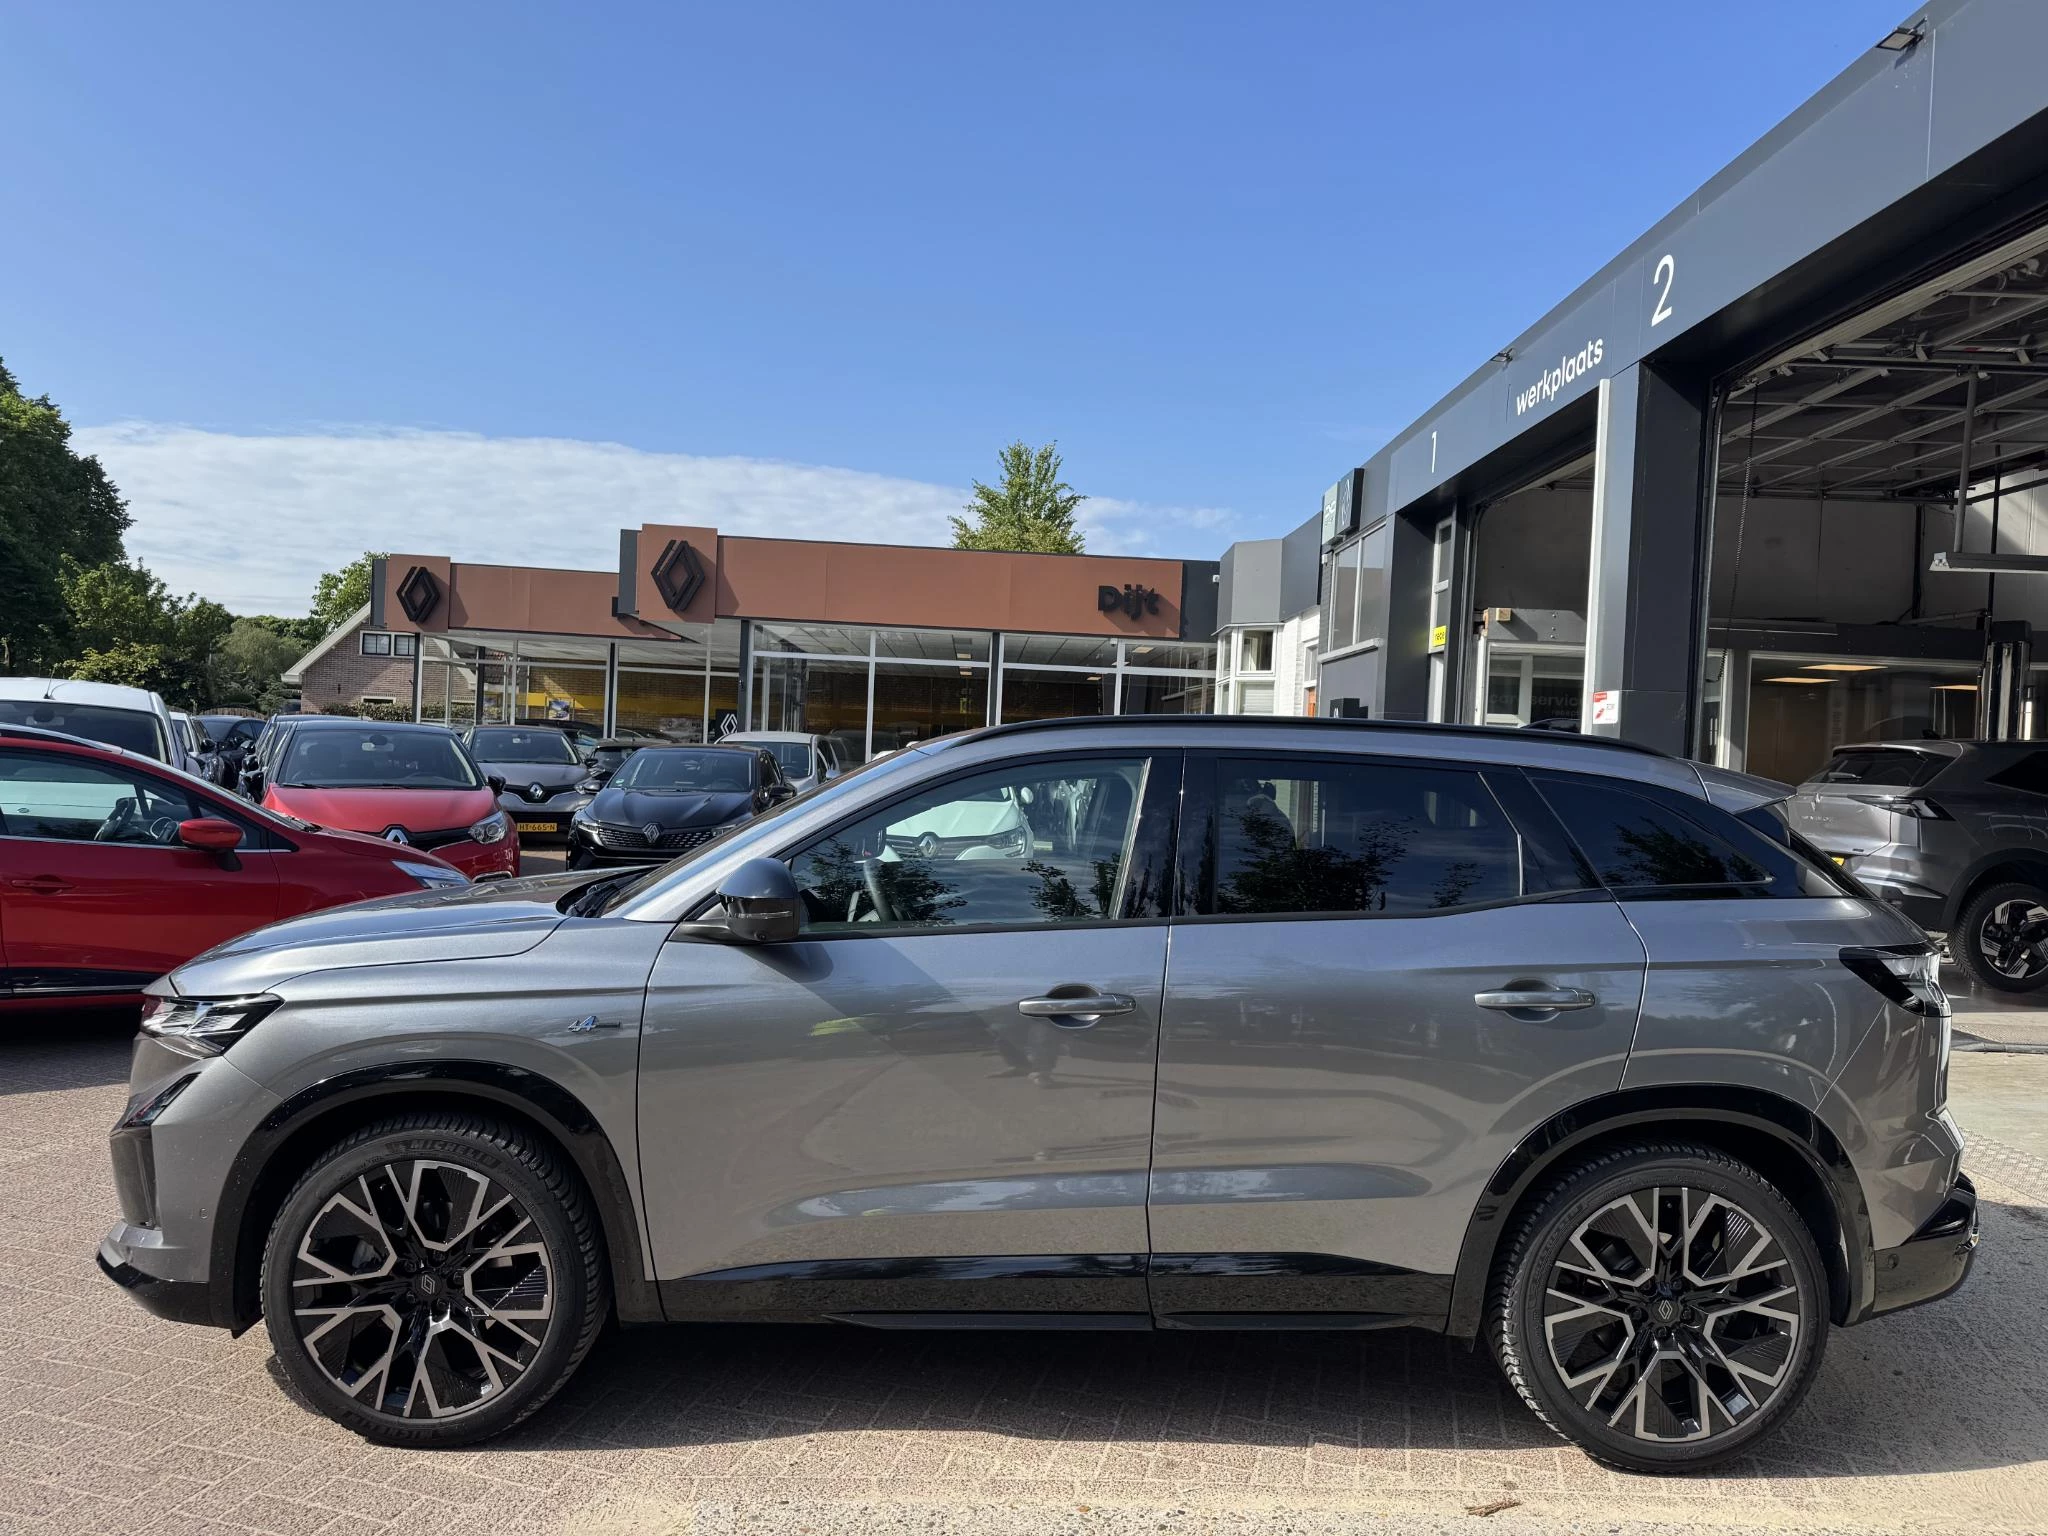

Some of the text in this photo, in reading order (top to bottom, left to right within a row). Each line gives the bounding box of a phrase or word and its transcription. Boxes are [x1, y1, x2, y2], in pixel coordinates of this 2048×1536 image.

[1651, 254, 1675, 328] 2
[1516, 338, 1604, 416] werkplaats
[1431, 431, 1437, 474] 1
